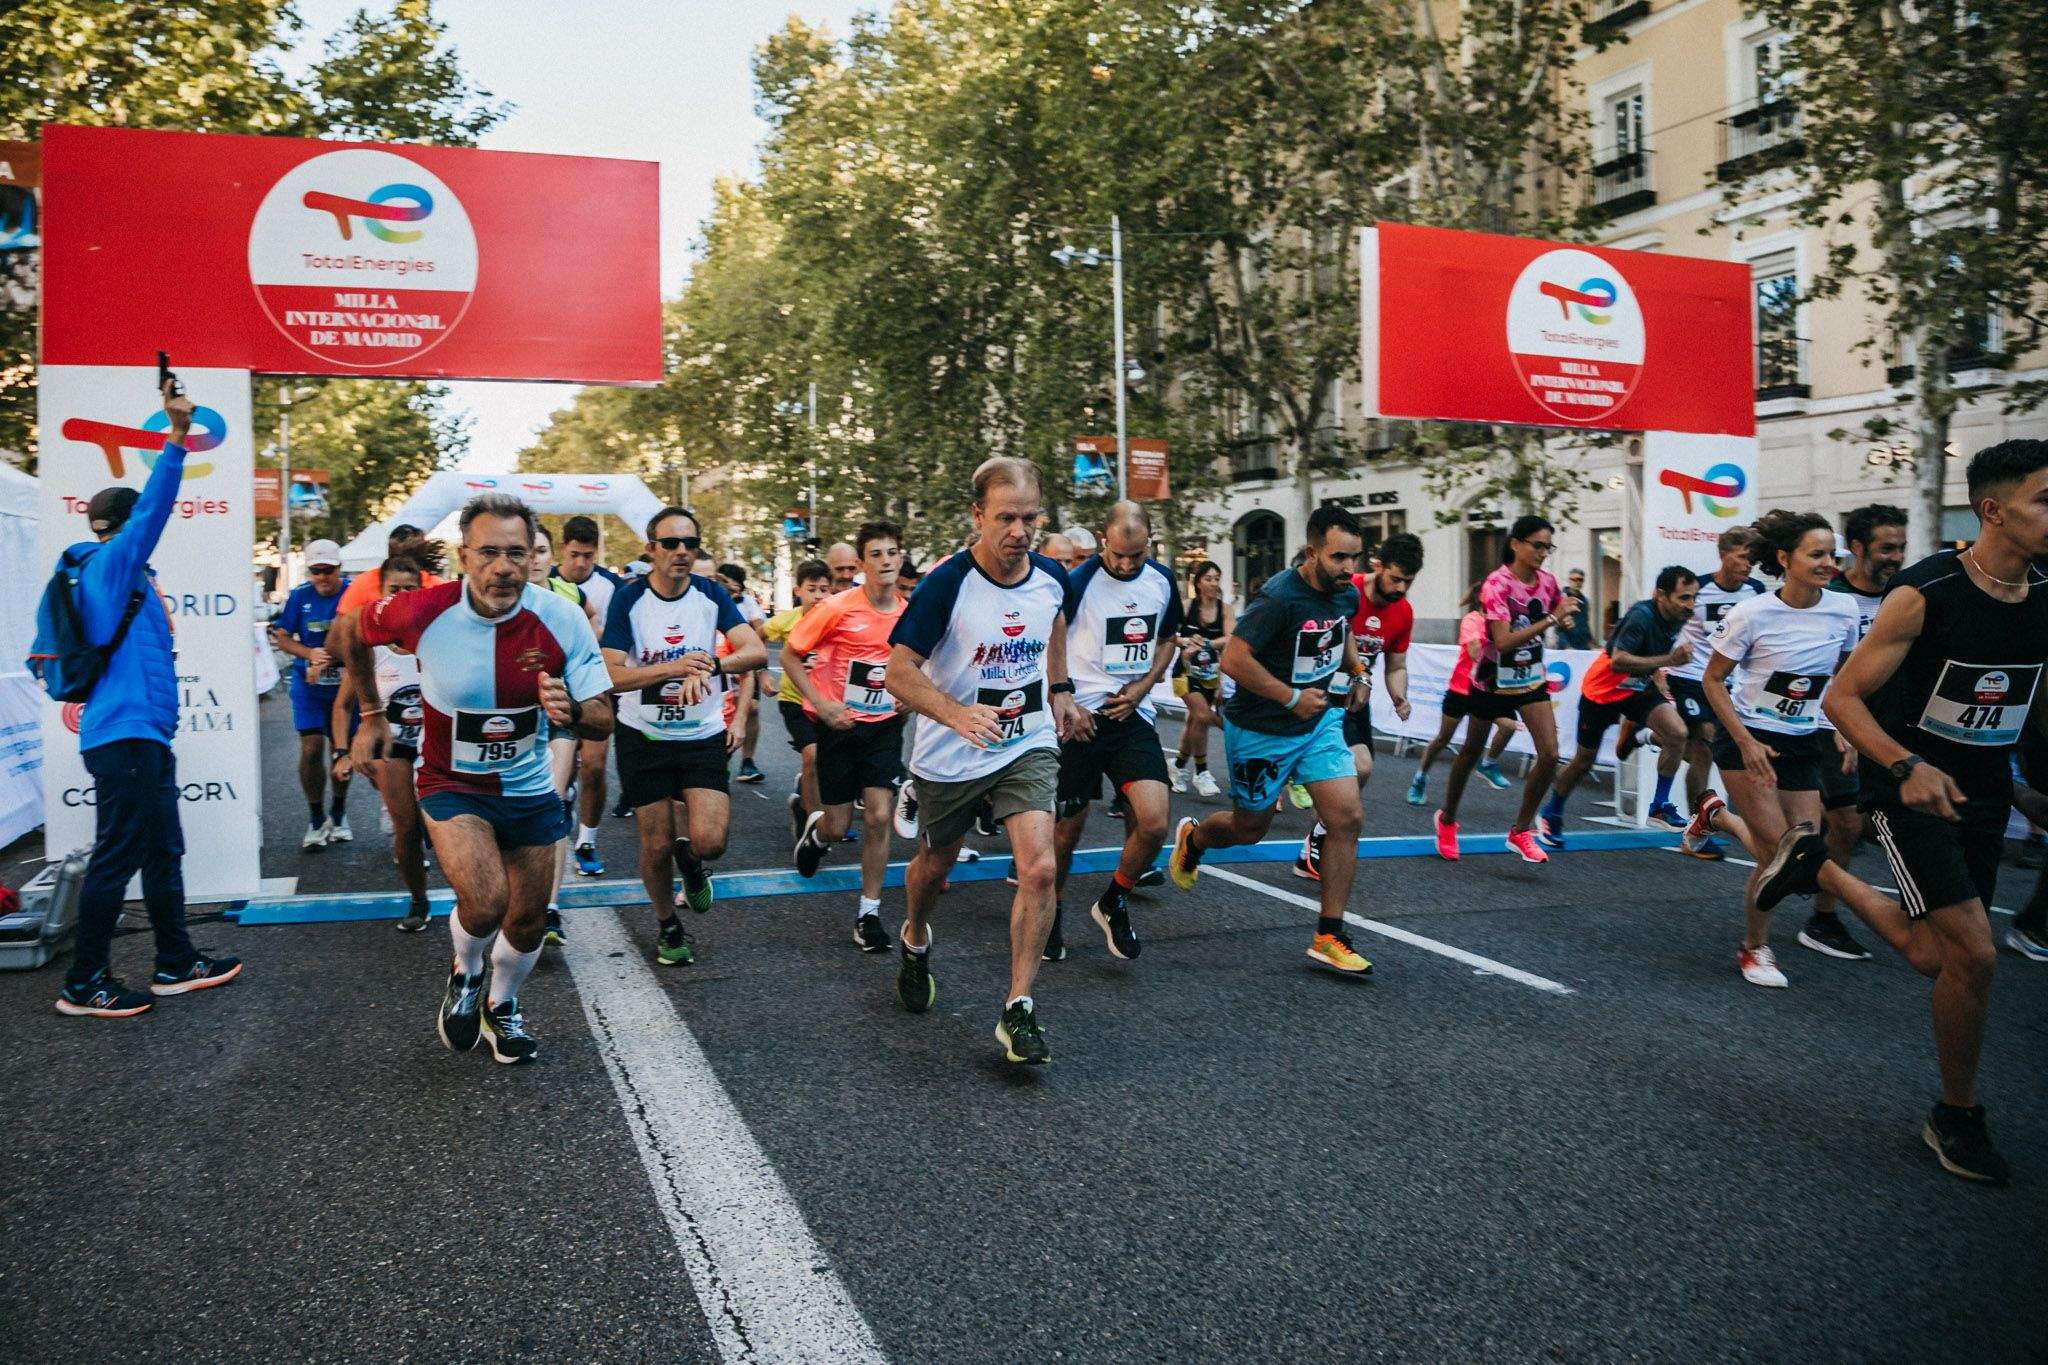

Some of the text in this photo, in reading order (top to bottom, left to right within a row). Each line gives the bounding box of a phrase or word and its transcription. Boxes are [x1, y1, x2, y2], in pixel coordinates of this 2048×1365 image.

[302, 253, 436, 275] TotalEnergies
[334, 292, 398, 309] MILLA
[310, 330, 422, 348] DE MADRID
[1124, 643, 1148, 661] 778
[657, 705, 685, 721] 755
[1685, 698, 1700, 715] 9
[1957, 705, 2004, 729] 474
[477, 741, 518, 762] 795
